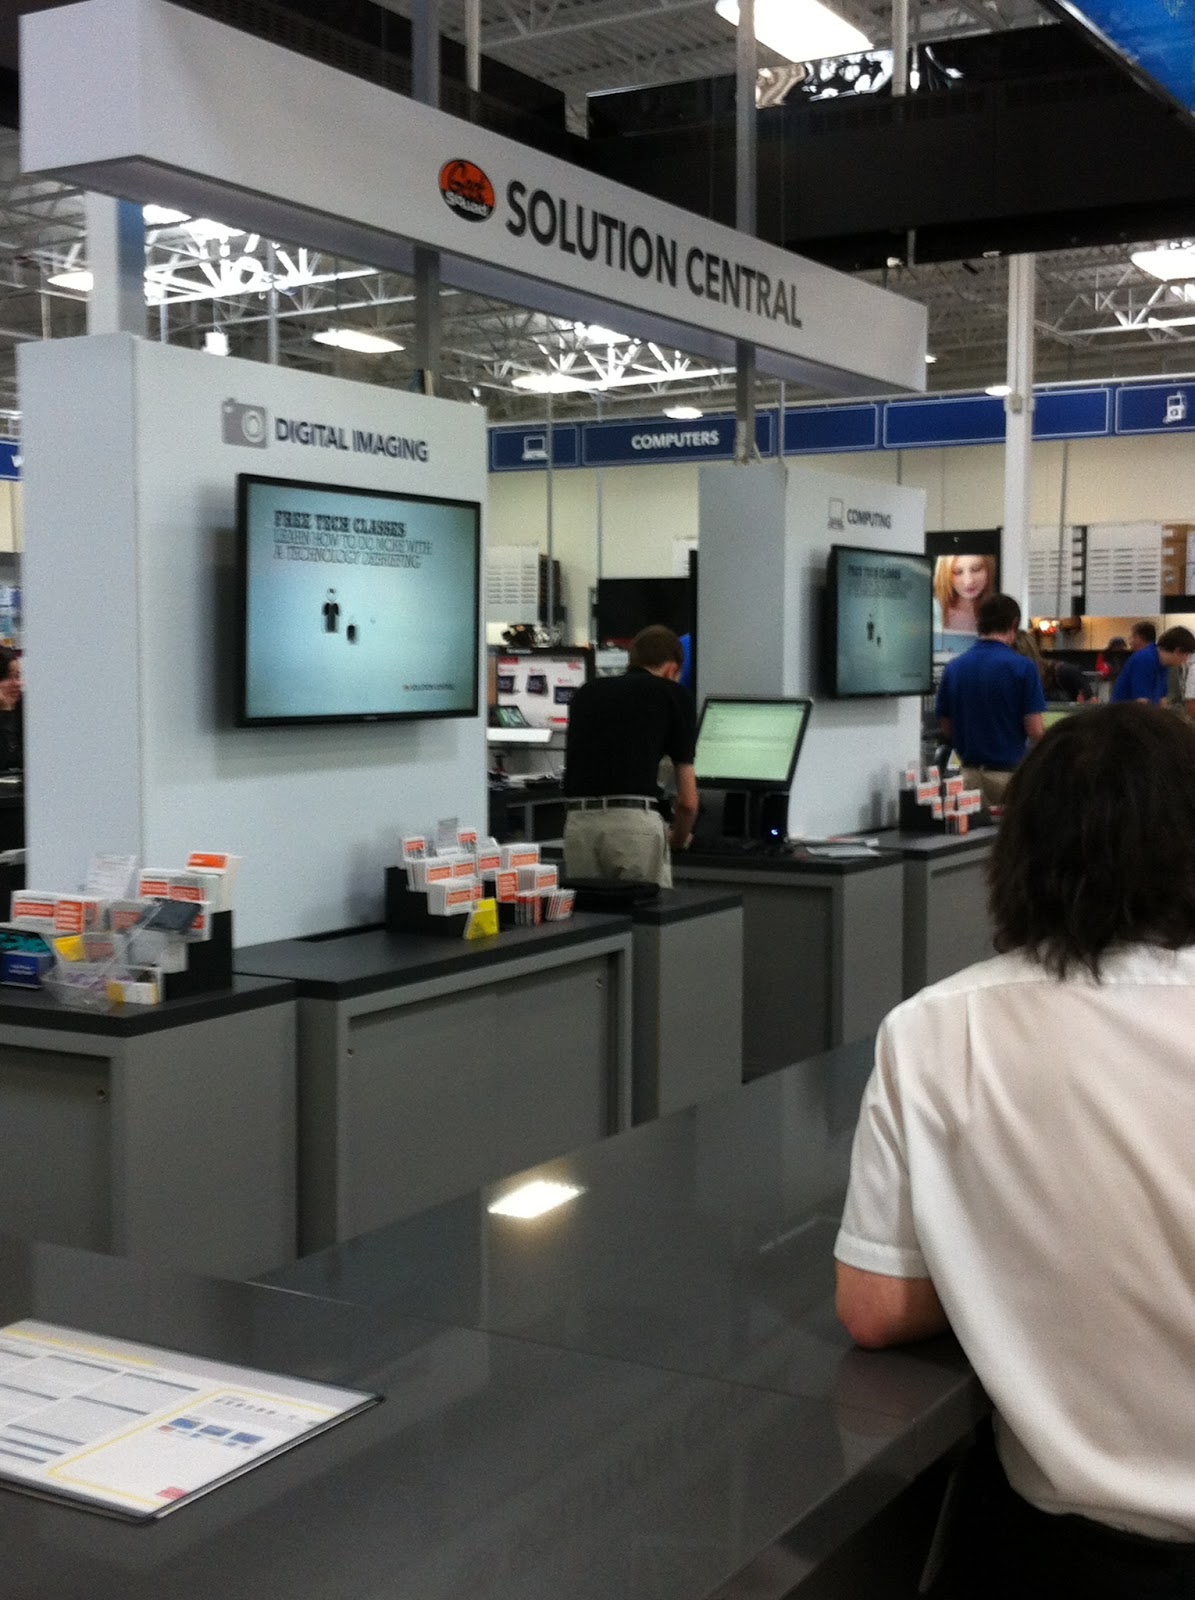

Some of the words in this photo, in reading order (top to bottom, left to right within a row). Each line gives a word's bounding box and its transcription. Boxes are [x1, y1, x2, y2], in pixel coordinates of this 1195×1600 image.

[504, 179, 677, 288] SOLUTION
[685, 246, 803, 329] CENTRAL
[275, 417, 349, 451] DIGITAL
[352, 429, 428, 463] IMAGING
[631, 430, 720, 450] COMPUTERS
[846, 508, 892, 530] COMPUTING
